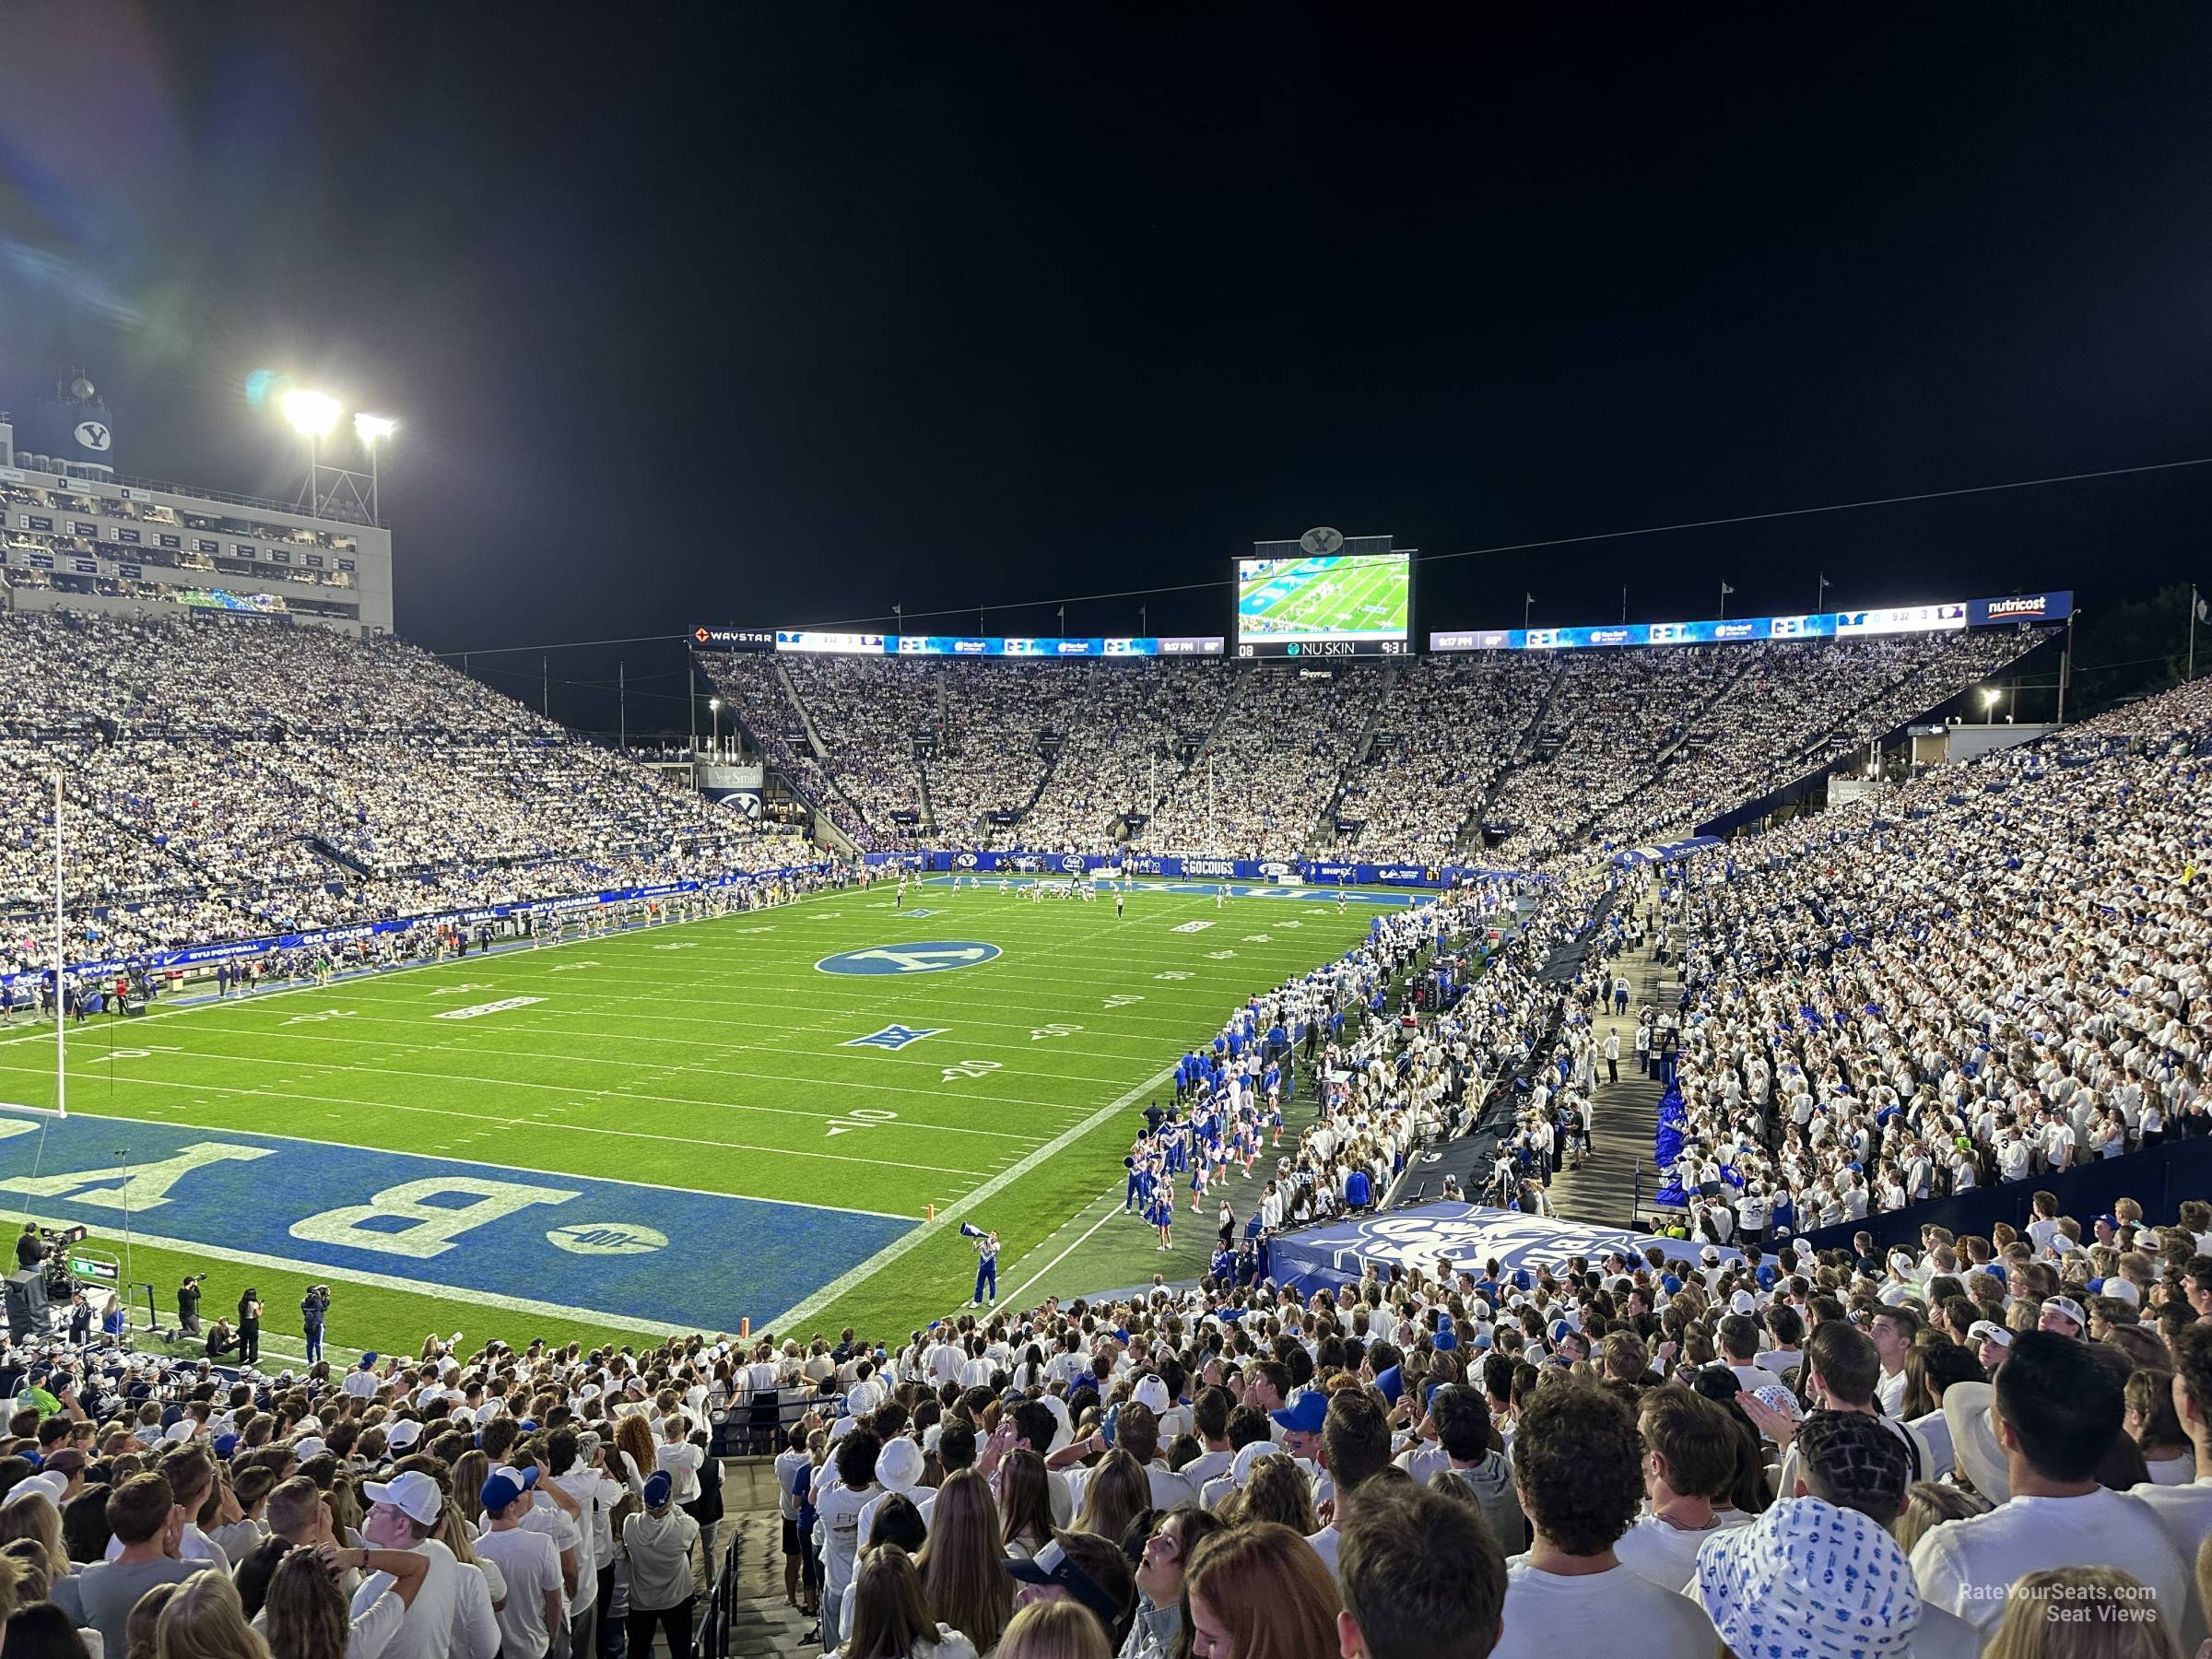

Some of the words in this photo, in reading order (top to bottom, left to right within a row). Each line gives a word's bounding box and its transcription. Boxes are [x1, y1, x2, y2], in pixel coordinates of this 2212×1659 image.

[1988, 597, 2045, 613] nutricost
[711, 631, 771, 642] WAYSTAR
[1239, 645, 1253, 657] 08
[1302, 642, 1323, 655] NU
[1324, 641, 1355, 654] SKIN
[1382, 641, 1407, 654] 9:31
[1672, 845, 1700, 856] ZIONS
[1427, 871, 1440, 881] 07
[532, 902, 553, 912] BYU
[553, 896, 600, 911] COUGARS
[302, 934, 324, 945] GO
[325, 927, 374, 942] COUGS
[189, 950, 210, 959] BYU
[210, 945, 259, 958] FOOTBALL
[1030, 1023, 1085, 1038] 30
[941, 1060, 1004, 1078] 20
[825, 1109, 900, 1128] 10
